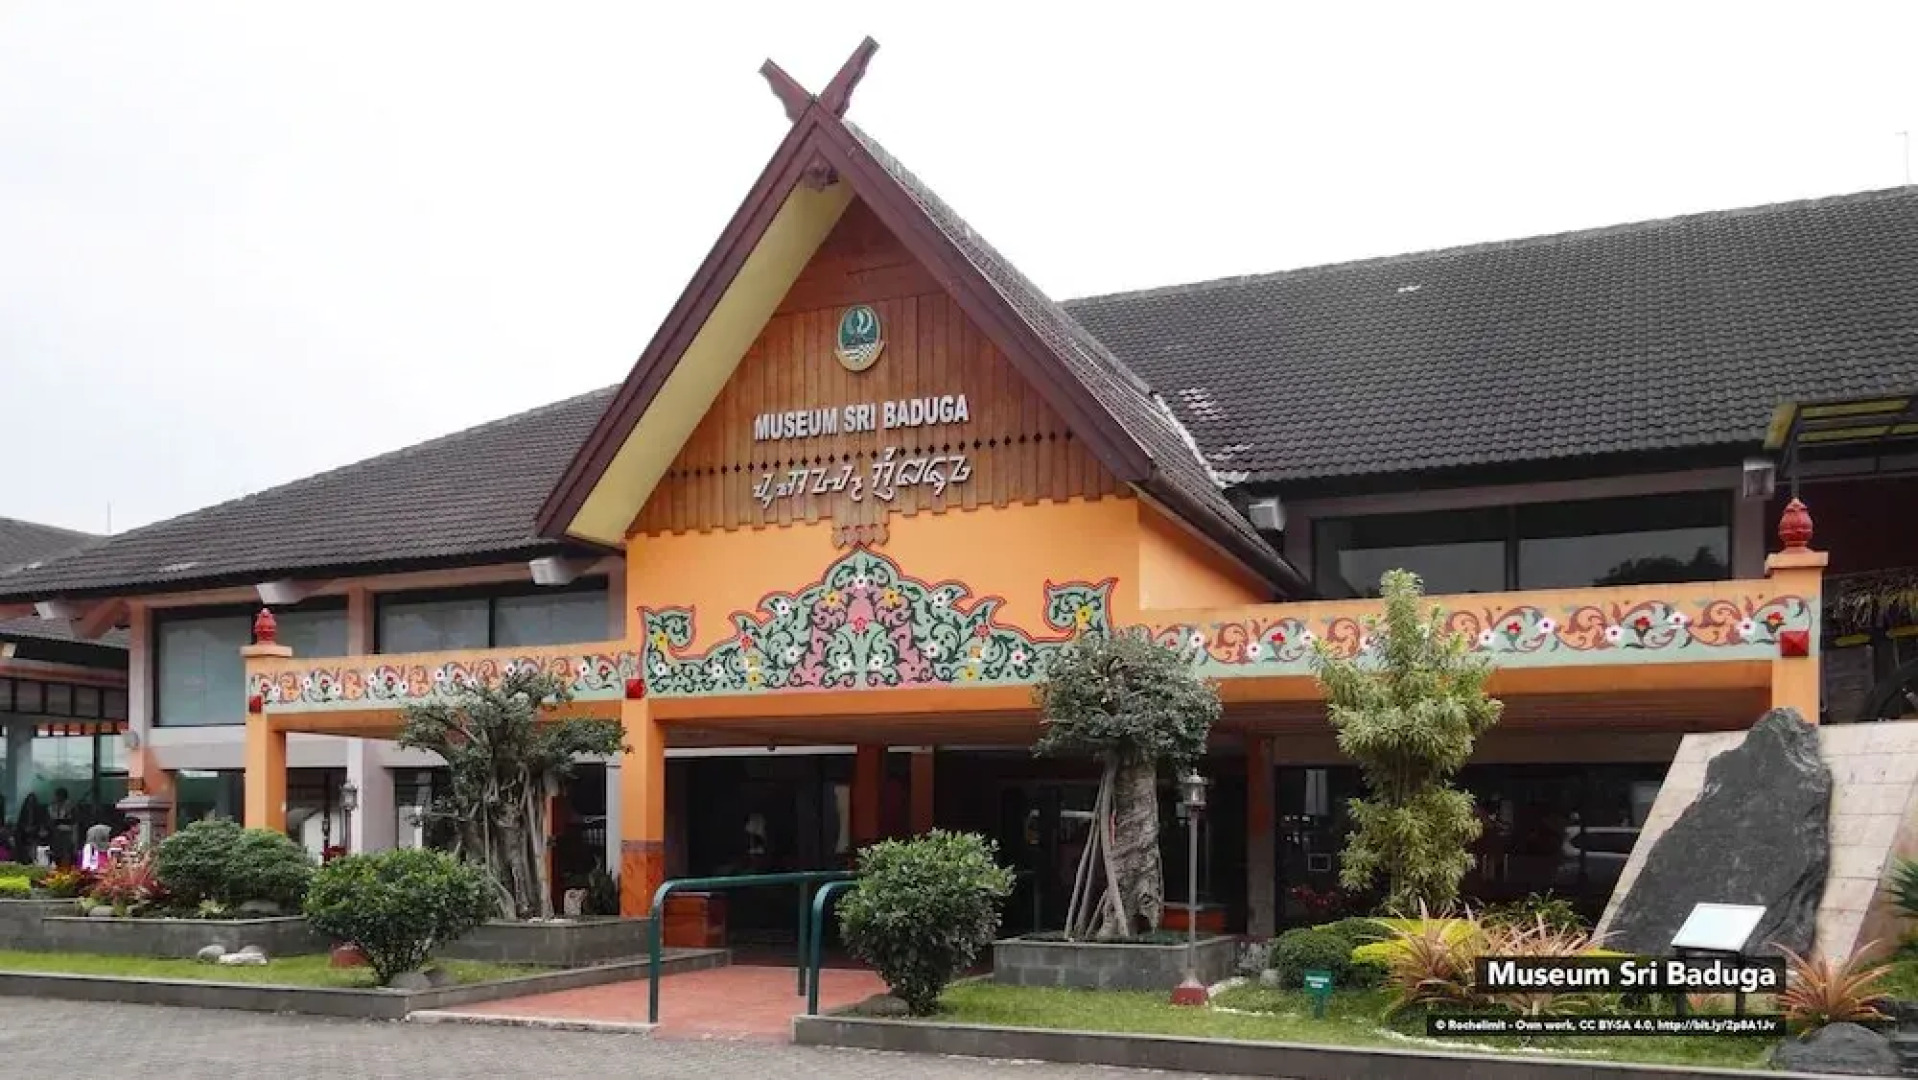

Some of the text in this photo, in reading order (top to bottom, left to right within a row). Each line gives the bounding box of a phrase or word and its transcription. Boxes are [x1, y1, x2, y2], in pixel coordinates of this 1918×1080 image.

[754, 393, 970, 440] MUSEUM SRI BADUGA
